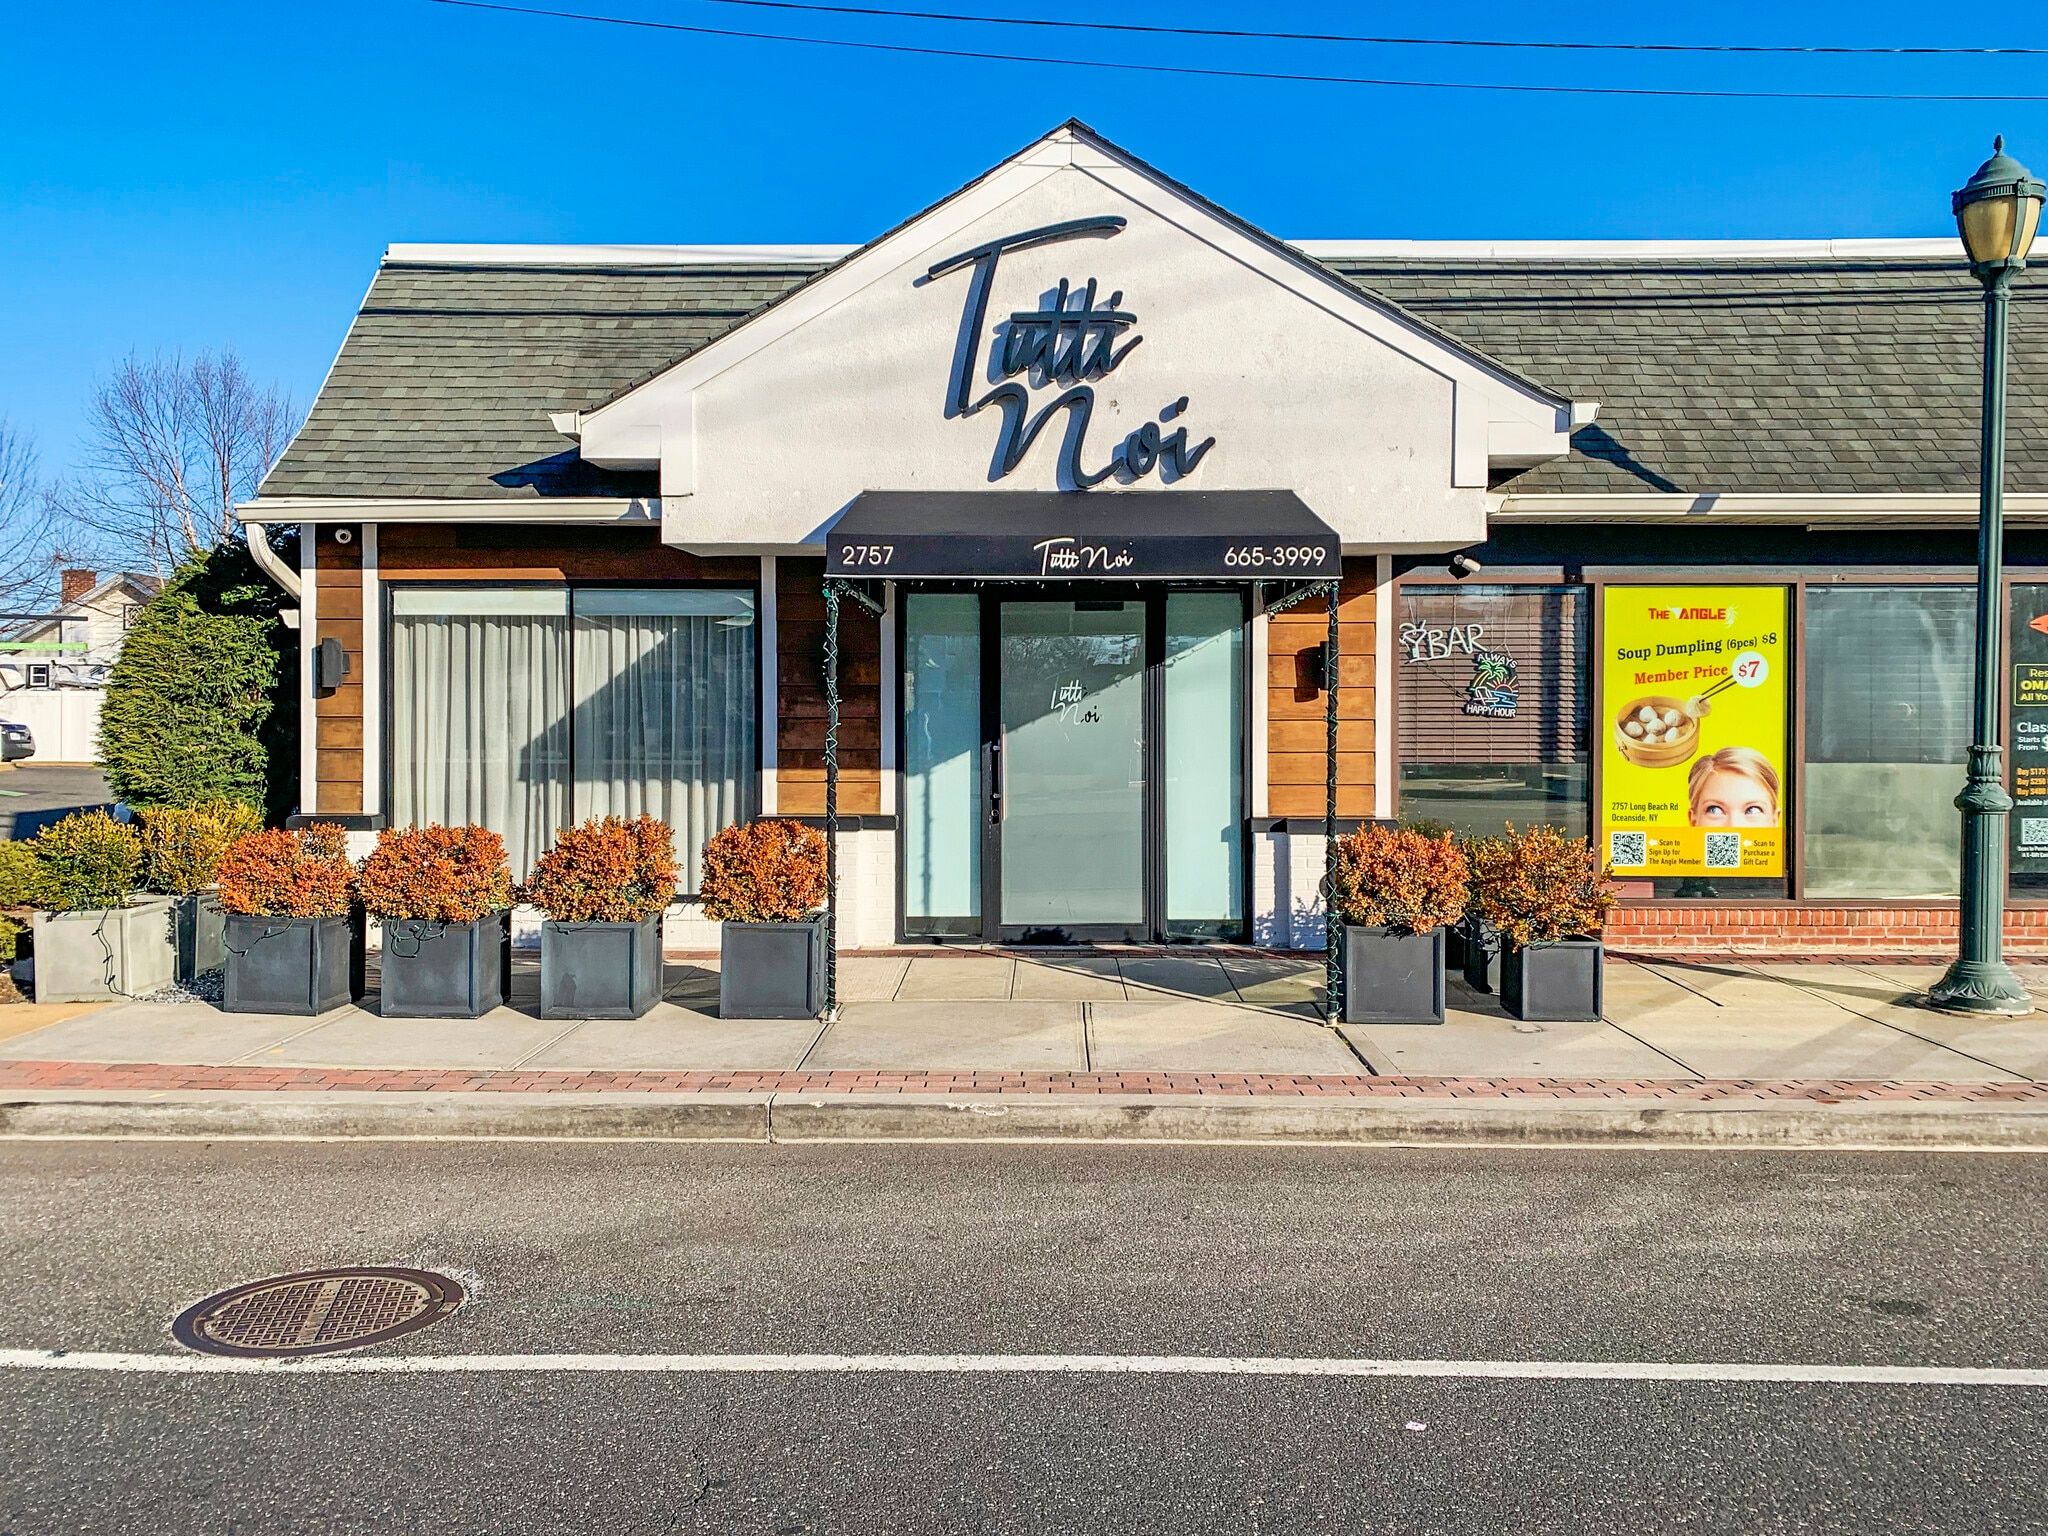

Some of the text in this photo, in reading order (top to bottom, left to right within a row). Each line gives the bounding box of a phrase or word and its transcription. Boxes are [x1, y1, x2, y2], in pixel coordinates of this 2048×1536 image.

[928, 215, 1144, 415] Tutti
[962, 381, 1216, 490] Noi
[842, 537, 1326, 576] 2757 Tutti Noi 665-3999
[1679, 607, 1727, 620] ANGLE
[1427, 623, 1488, 660] BAR
[1617, 632, 1777, 661] Soup Dumpling (6pcs) $8
[1477, 652, 1518, 669] ALWAYS
[1634, 660, 1761, 685] Member Price $7
[2020, 692, 2034, 701] All
[1466, 703, 1516, 718] HAPPY HOUR
[1612, 802, 1678, 812] 2757 Long Beach Rd
[1612, 814, 1658, 823] Oceanside, NY
[1659, 839, 1681, 847] Scan to
[1754, 839, 1776, 848] Scan to
[1649, 848, 1681, 857] Sign Up for
[1743, 849, 1769, 857] Purchase
[1649, 857, 1702, 867] The Angle Member
[1743, 858, 1769, 867] Gift Card
